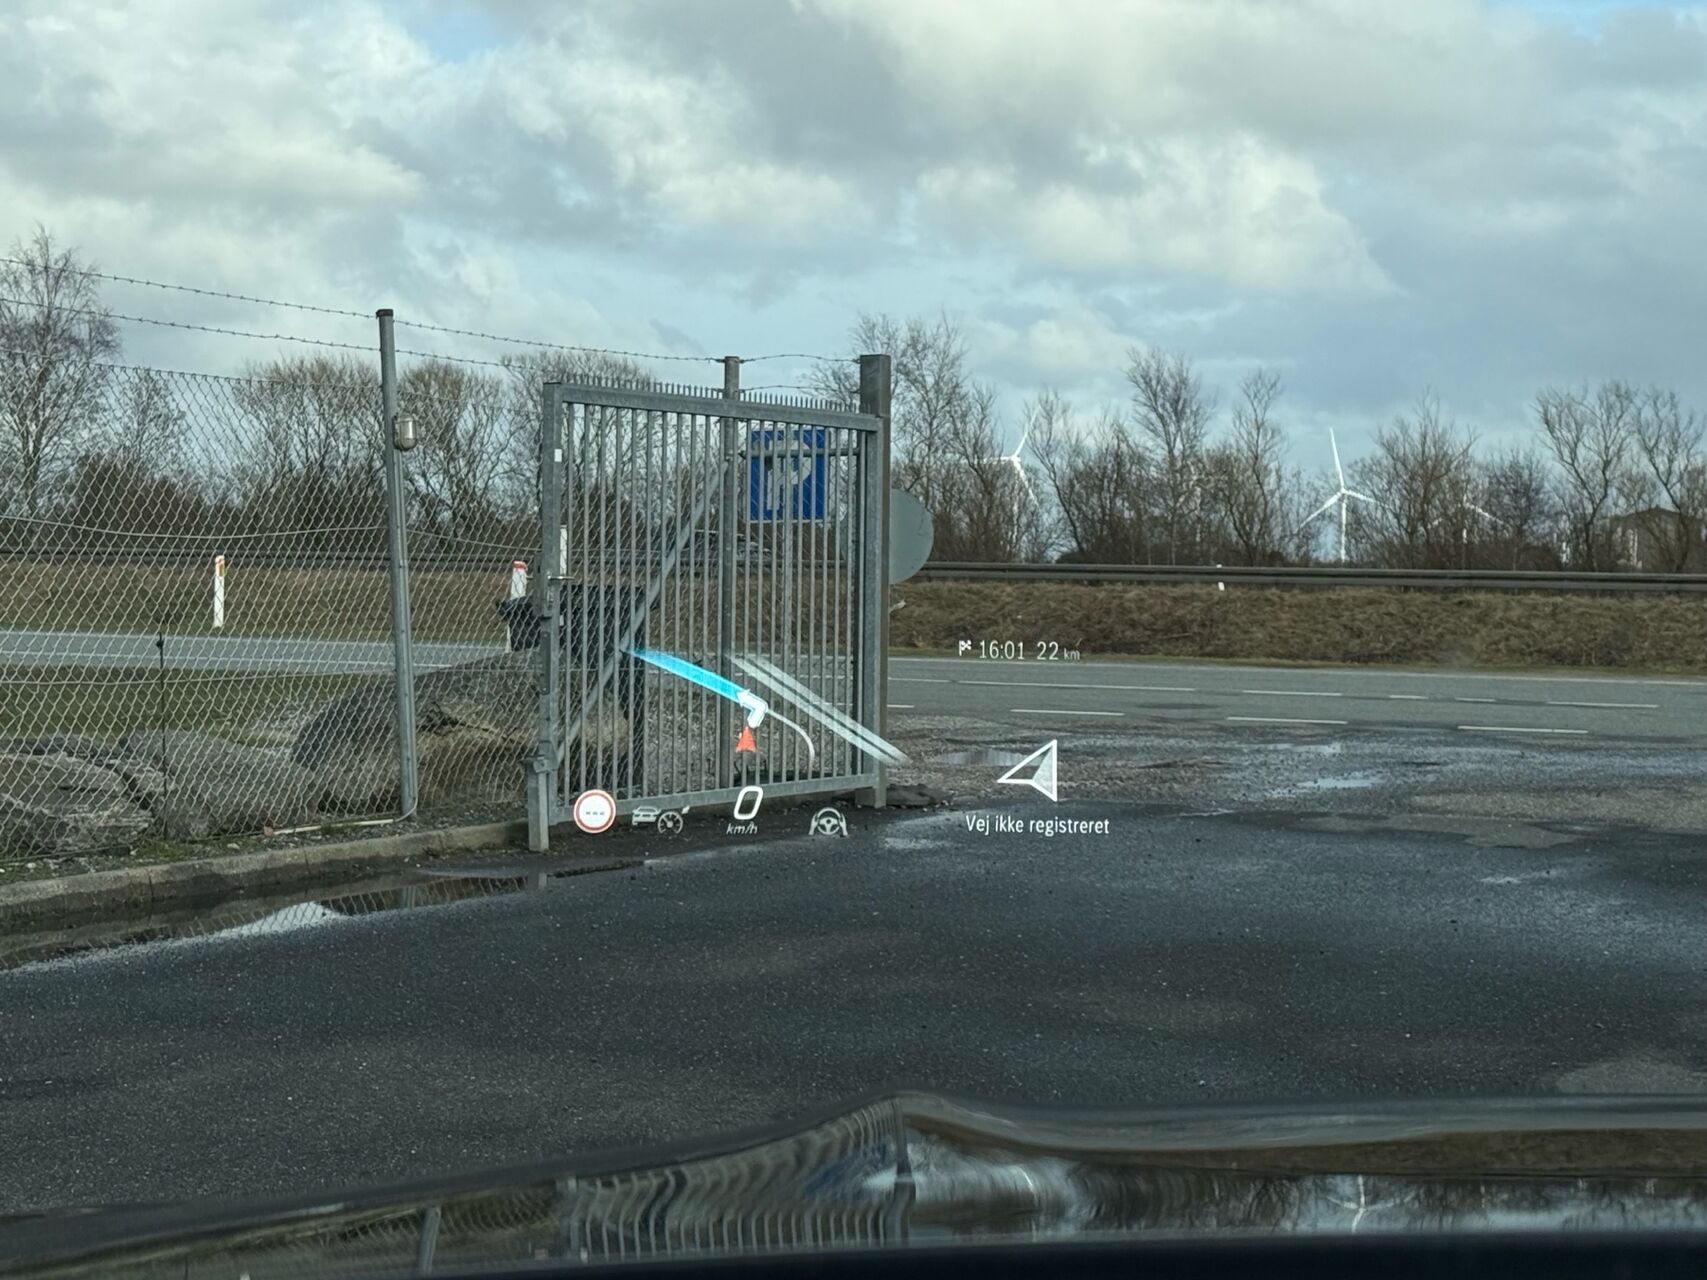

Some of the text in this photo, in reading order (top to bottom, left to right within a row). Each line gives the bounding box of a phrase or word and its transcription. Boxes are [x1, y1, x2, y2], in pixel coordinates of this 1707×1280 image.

[766, 439, 812, 511] P
[979, 639, 1080, 661] 16:01 22 km
[733, 785, 764, 821] 0
[726, 820, 758, 836] km/h
[965, 814, 1110, 837] Vej ikke registreret
